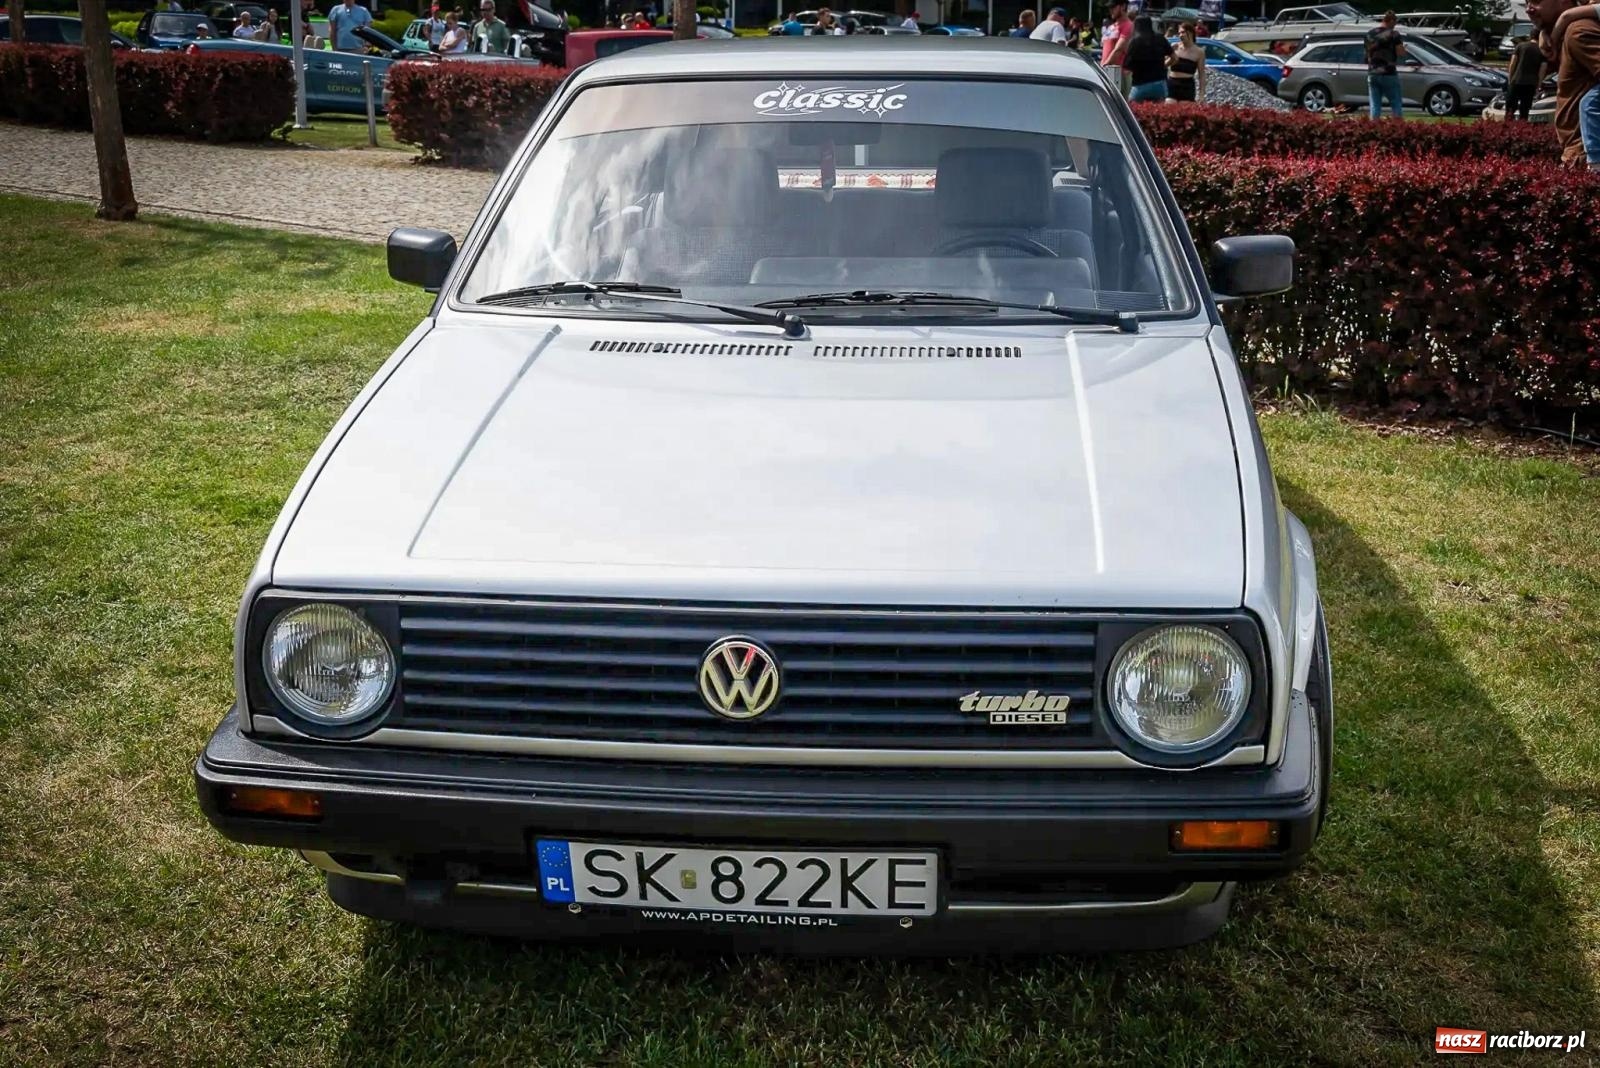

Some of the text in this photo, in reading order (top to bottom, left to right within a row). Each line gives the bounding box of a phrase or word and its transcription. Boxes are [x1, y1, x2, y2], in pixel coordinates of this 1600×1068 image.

[753, 87, 908, 110] classic
[959, 690, 1070, 712] turbo
[991, 713, 1064, 723] DIESEL
[546, 877, 570, 892] PL
[583, 848, 928, 910] SK 822KE
